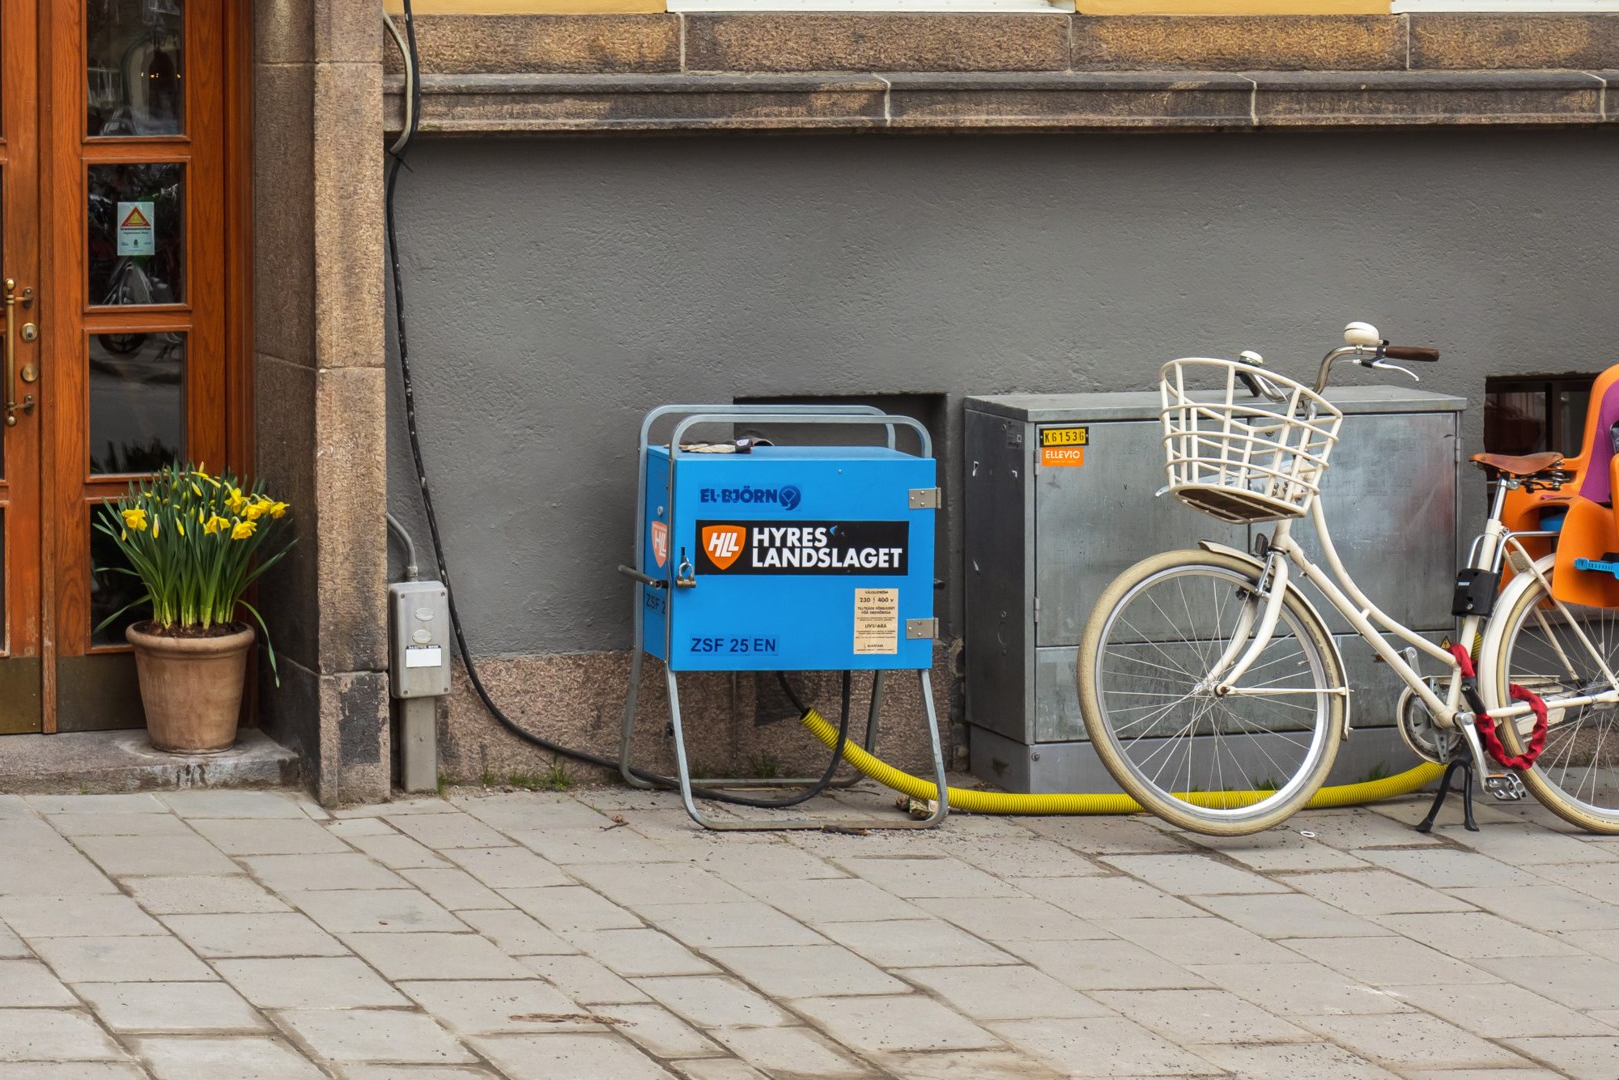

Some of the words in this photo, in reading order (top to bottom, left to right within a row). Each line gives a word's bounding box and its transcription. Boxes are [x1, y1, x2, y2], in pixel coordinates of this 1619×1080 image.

[1045, 450, 1081, 459] ELLEVIO
[752, 528, 828, 547] HYRES
[752, 547, 903, 568] LANDSLAGET
[690, 637, 724, 653] ZSF
[730, 636, 749, 652] 25
[753, 637, 776, 652] EN
